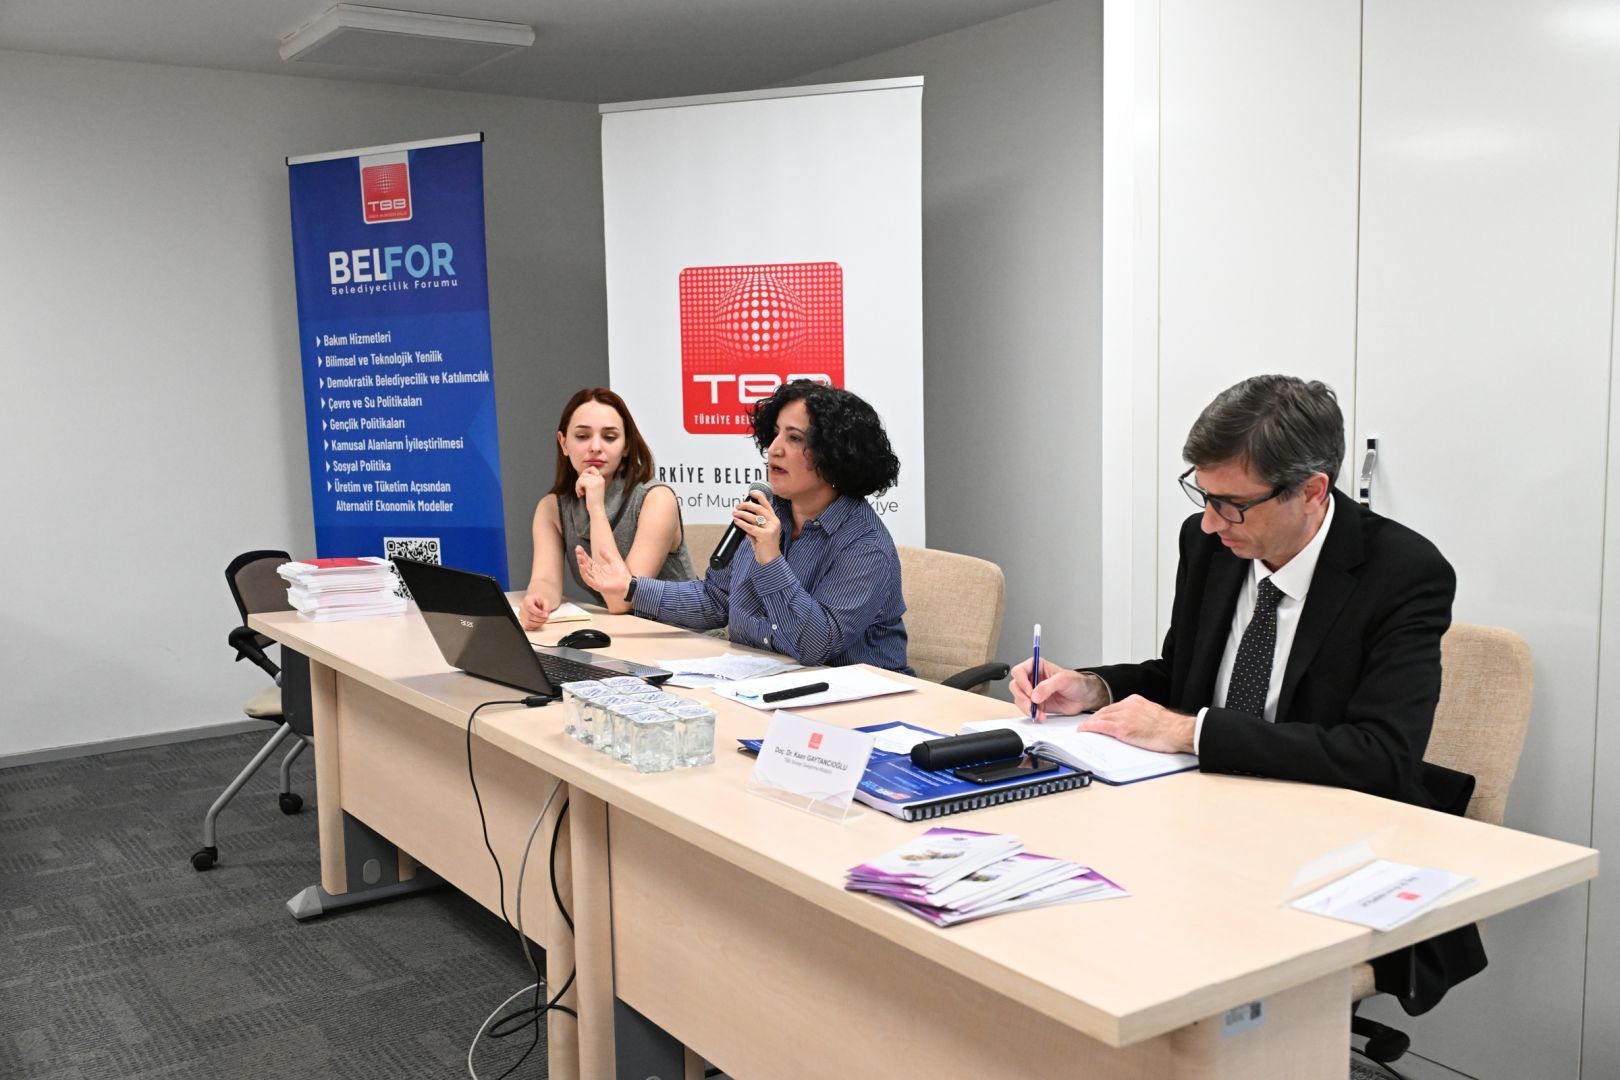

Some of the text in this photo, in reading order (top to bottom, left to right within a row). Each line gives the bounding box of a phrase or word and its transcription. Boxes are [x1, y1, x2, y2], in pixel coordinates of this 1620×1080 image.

[367, 198, 406, 212] TBB
[329, 242, 455, 285] BELFOR
[331, 279, 458, 295] Belediyecilik Forumu
[323, 331, 391, 346] Bakım Hizmetleri
[325, 350, 443, 368] Bilimsel ve Teknolojik Yenilik
[327, 370, 490, 389] Demokratik Belediyecilik ve Katılımcılık
[328, 395, 423, 412] Çevre ve Su Politikaları
[330, 417, 405, 432] Gençlik Politikaları
[694, 412, 731, 425] TÜRKİYE
[331, 435, 464, 452] Kamusal Alanların İyileştirilmesi
[333, 460, 391, 474] Sosyal Politika
[659, 463, 704, 483] RKİYE
[334, 478, 451, 494] Üretim ve Tüketim Açısından
[336, 499, 454, 512] Alternatif Ekonomik Modeller
[687, 493, 704, 507] of
